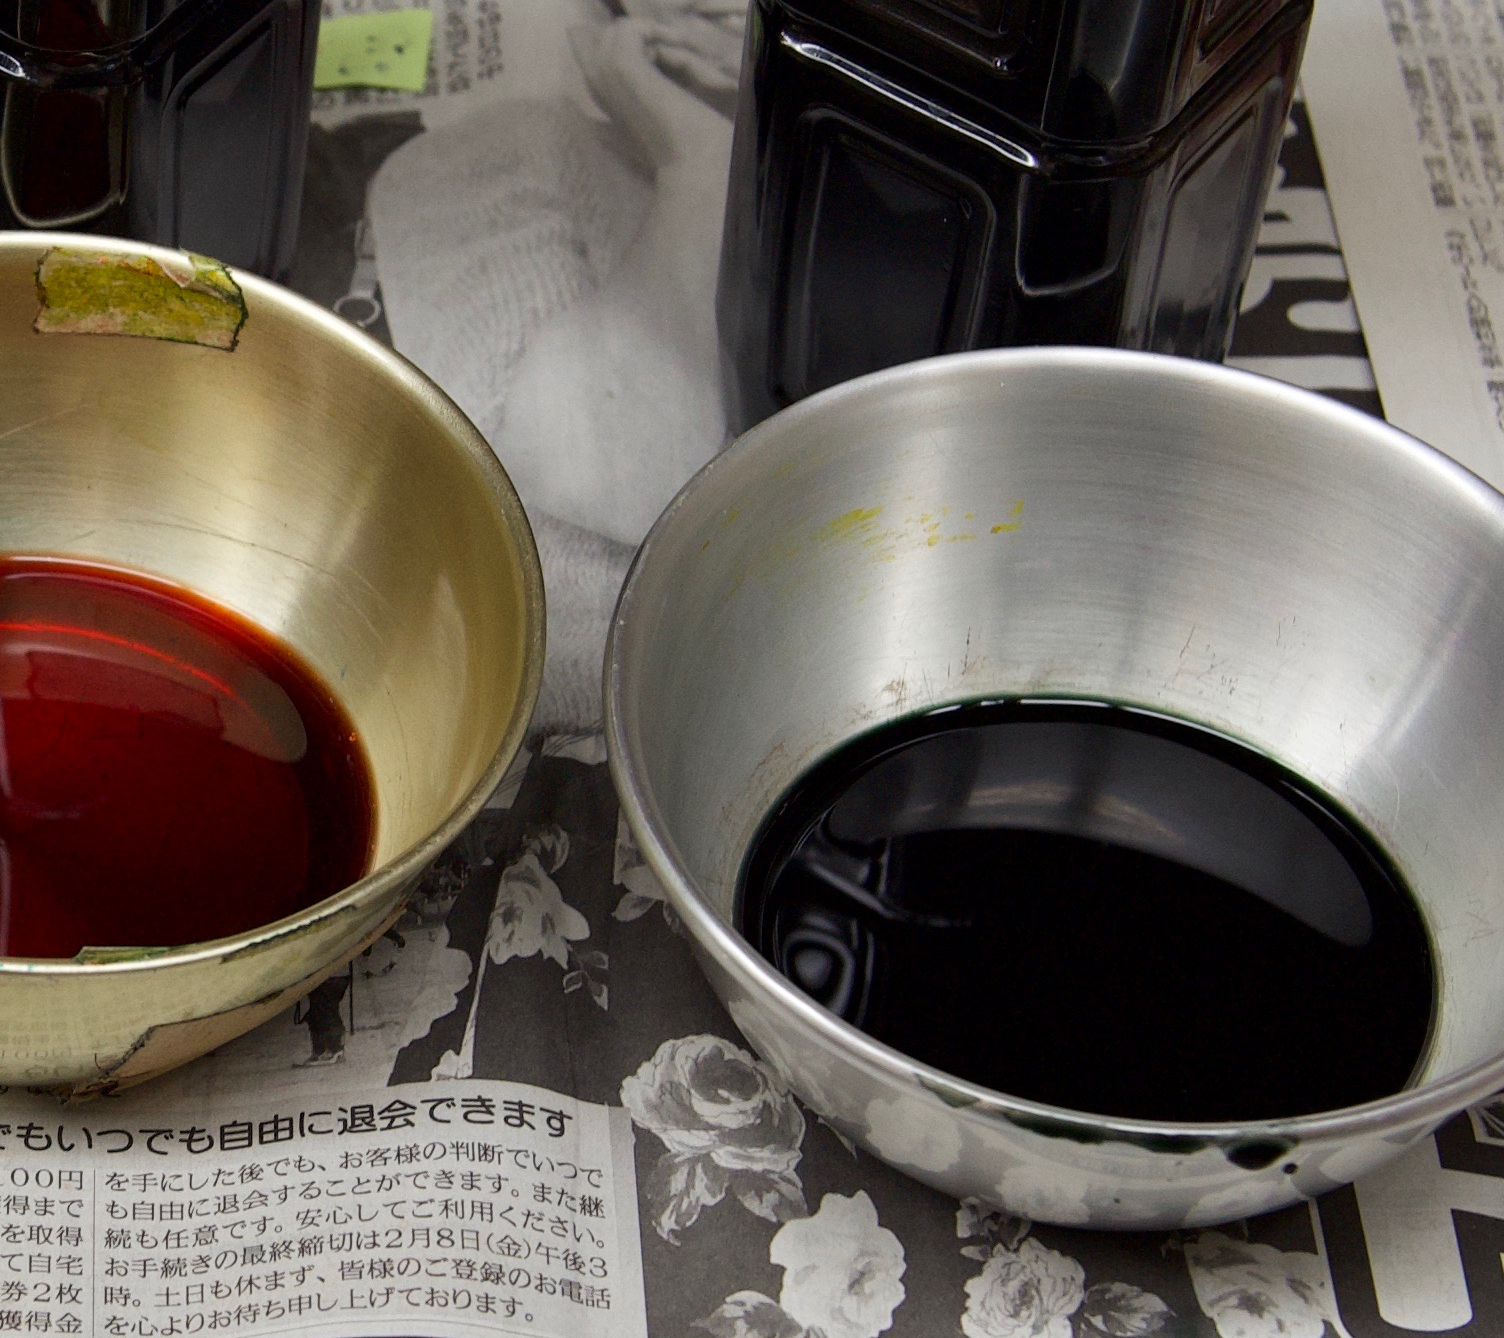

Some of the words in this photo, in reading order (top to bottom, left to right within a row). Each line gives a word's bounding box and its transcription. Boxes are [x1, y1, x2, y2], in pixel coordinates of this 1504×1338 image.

[103, 1139, 605, 1195] を手にした後でも、お客様の判断でいつで
[103, 1169, 607, 1222] も自由に退会することができます。また継
[103, 1201, 609, 1251] 続も任意です。安心してご利用ください。
[103, 1229, 609, 1280] お手続きの最終締切は2月8日(金)午後3
[103, 1259, 612, 1311] 時。土日も休まず、皆様のご登録のお電話
[103, 1288, 537, 1338] を心よりお待ち申し上げております。
